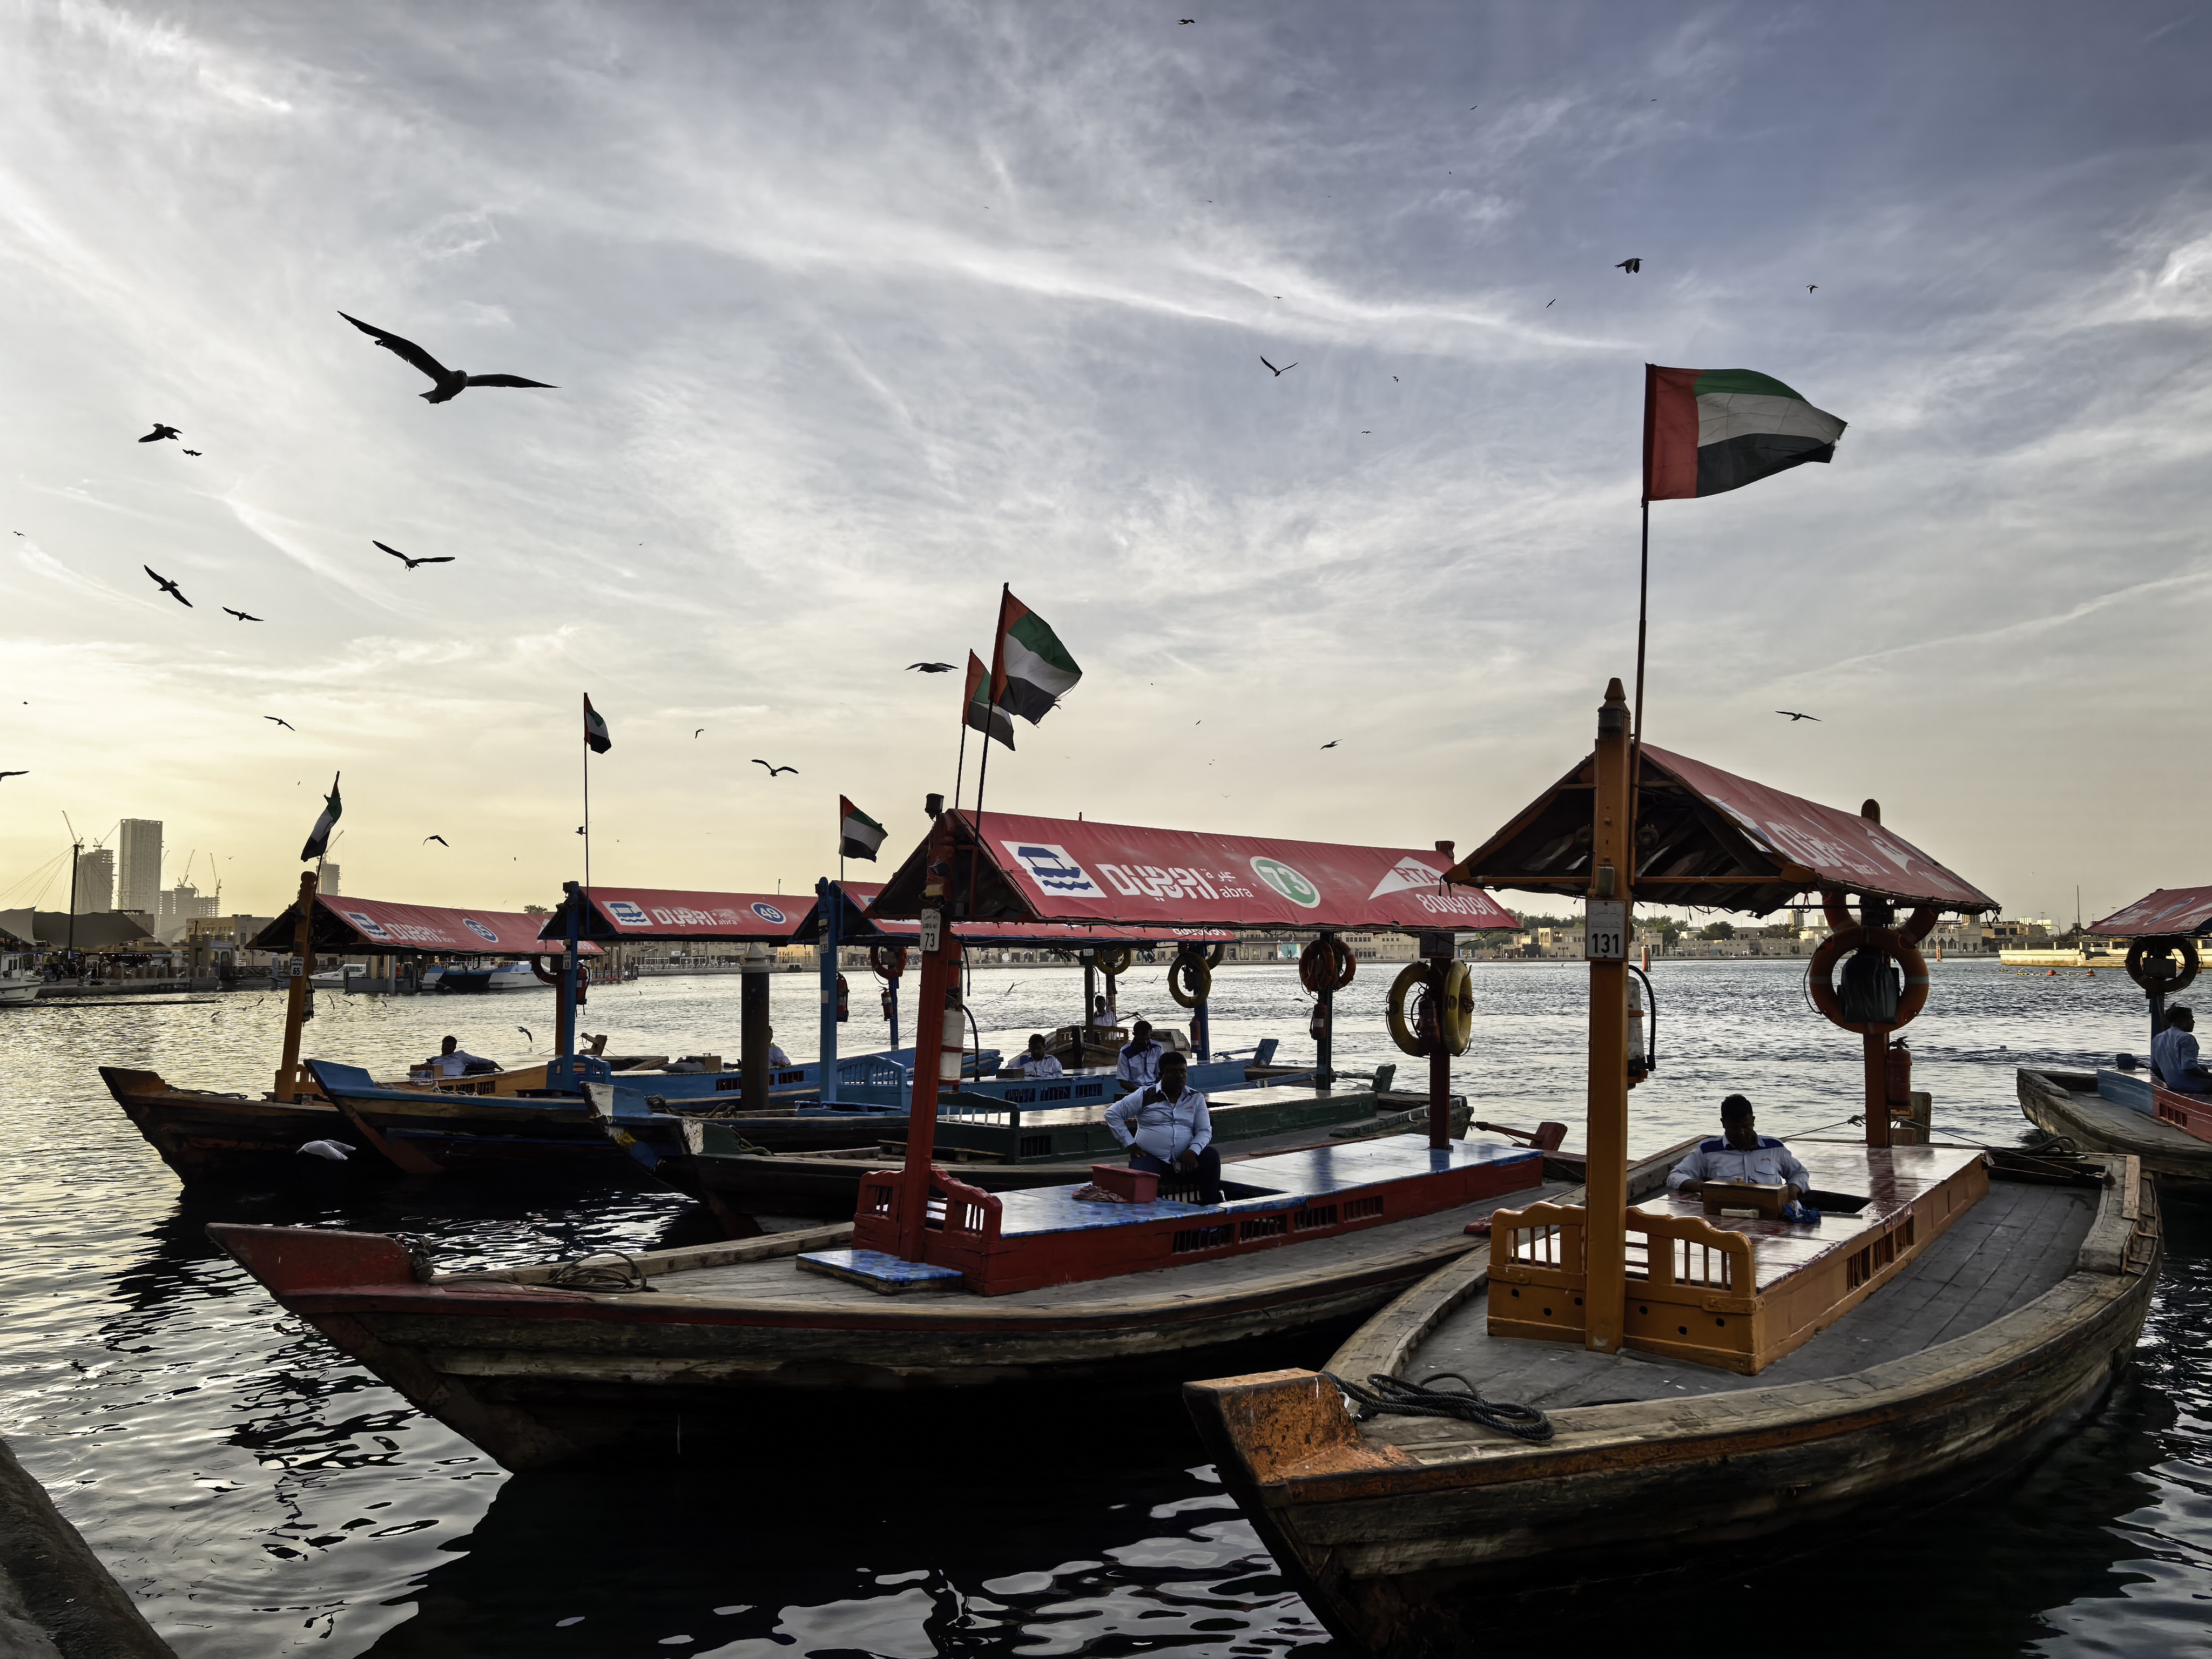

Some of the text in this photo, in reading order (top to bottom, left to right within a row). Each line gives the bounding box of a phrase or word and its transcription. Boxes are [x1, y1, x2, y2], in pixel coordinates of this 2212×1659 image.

[1259, 866, 1311, 896] 73
[1397, 867, 1440, 885] RTA
[1219, 886, 1254, 898] abra
[1415, 893, 1498, 915] 8009090
[760, 907, 781, 919] 49
[925, 933, 935, 950] 73
[1591, 933, 1619, 954] 131
[293, 967, 301, 975] 65
